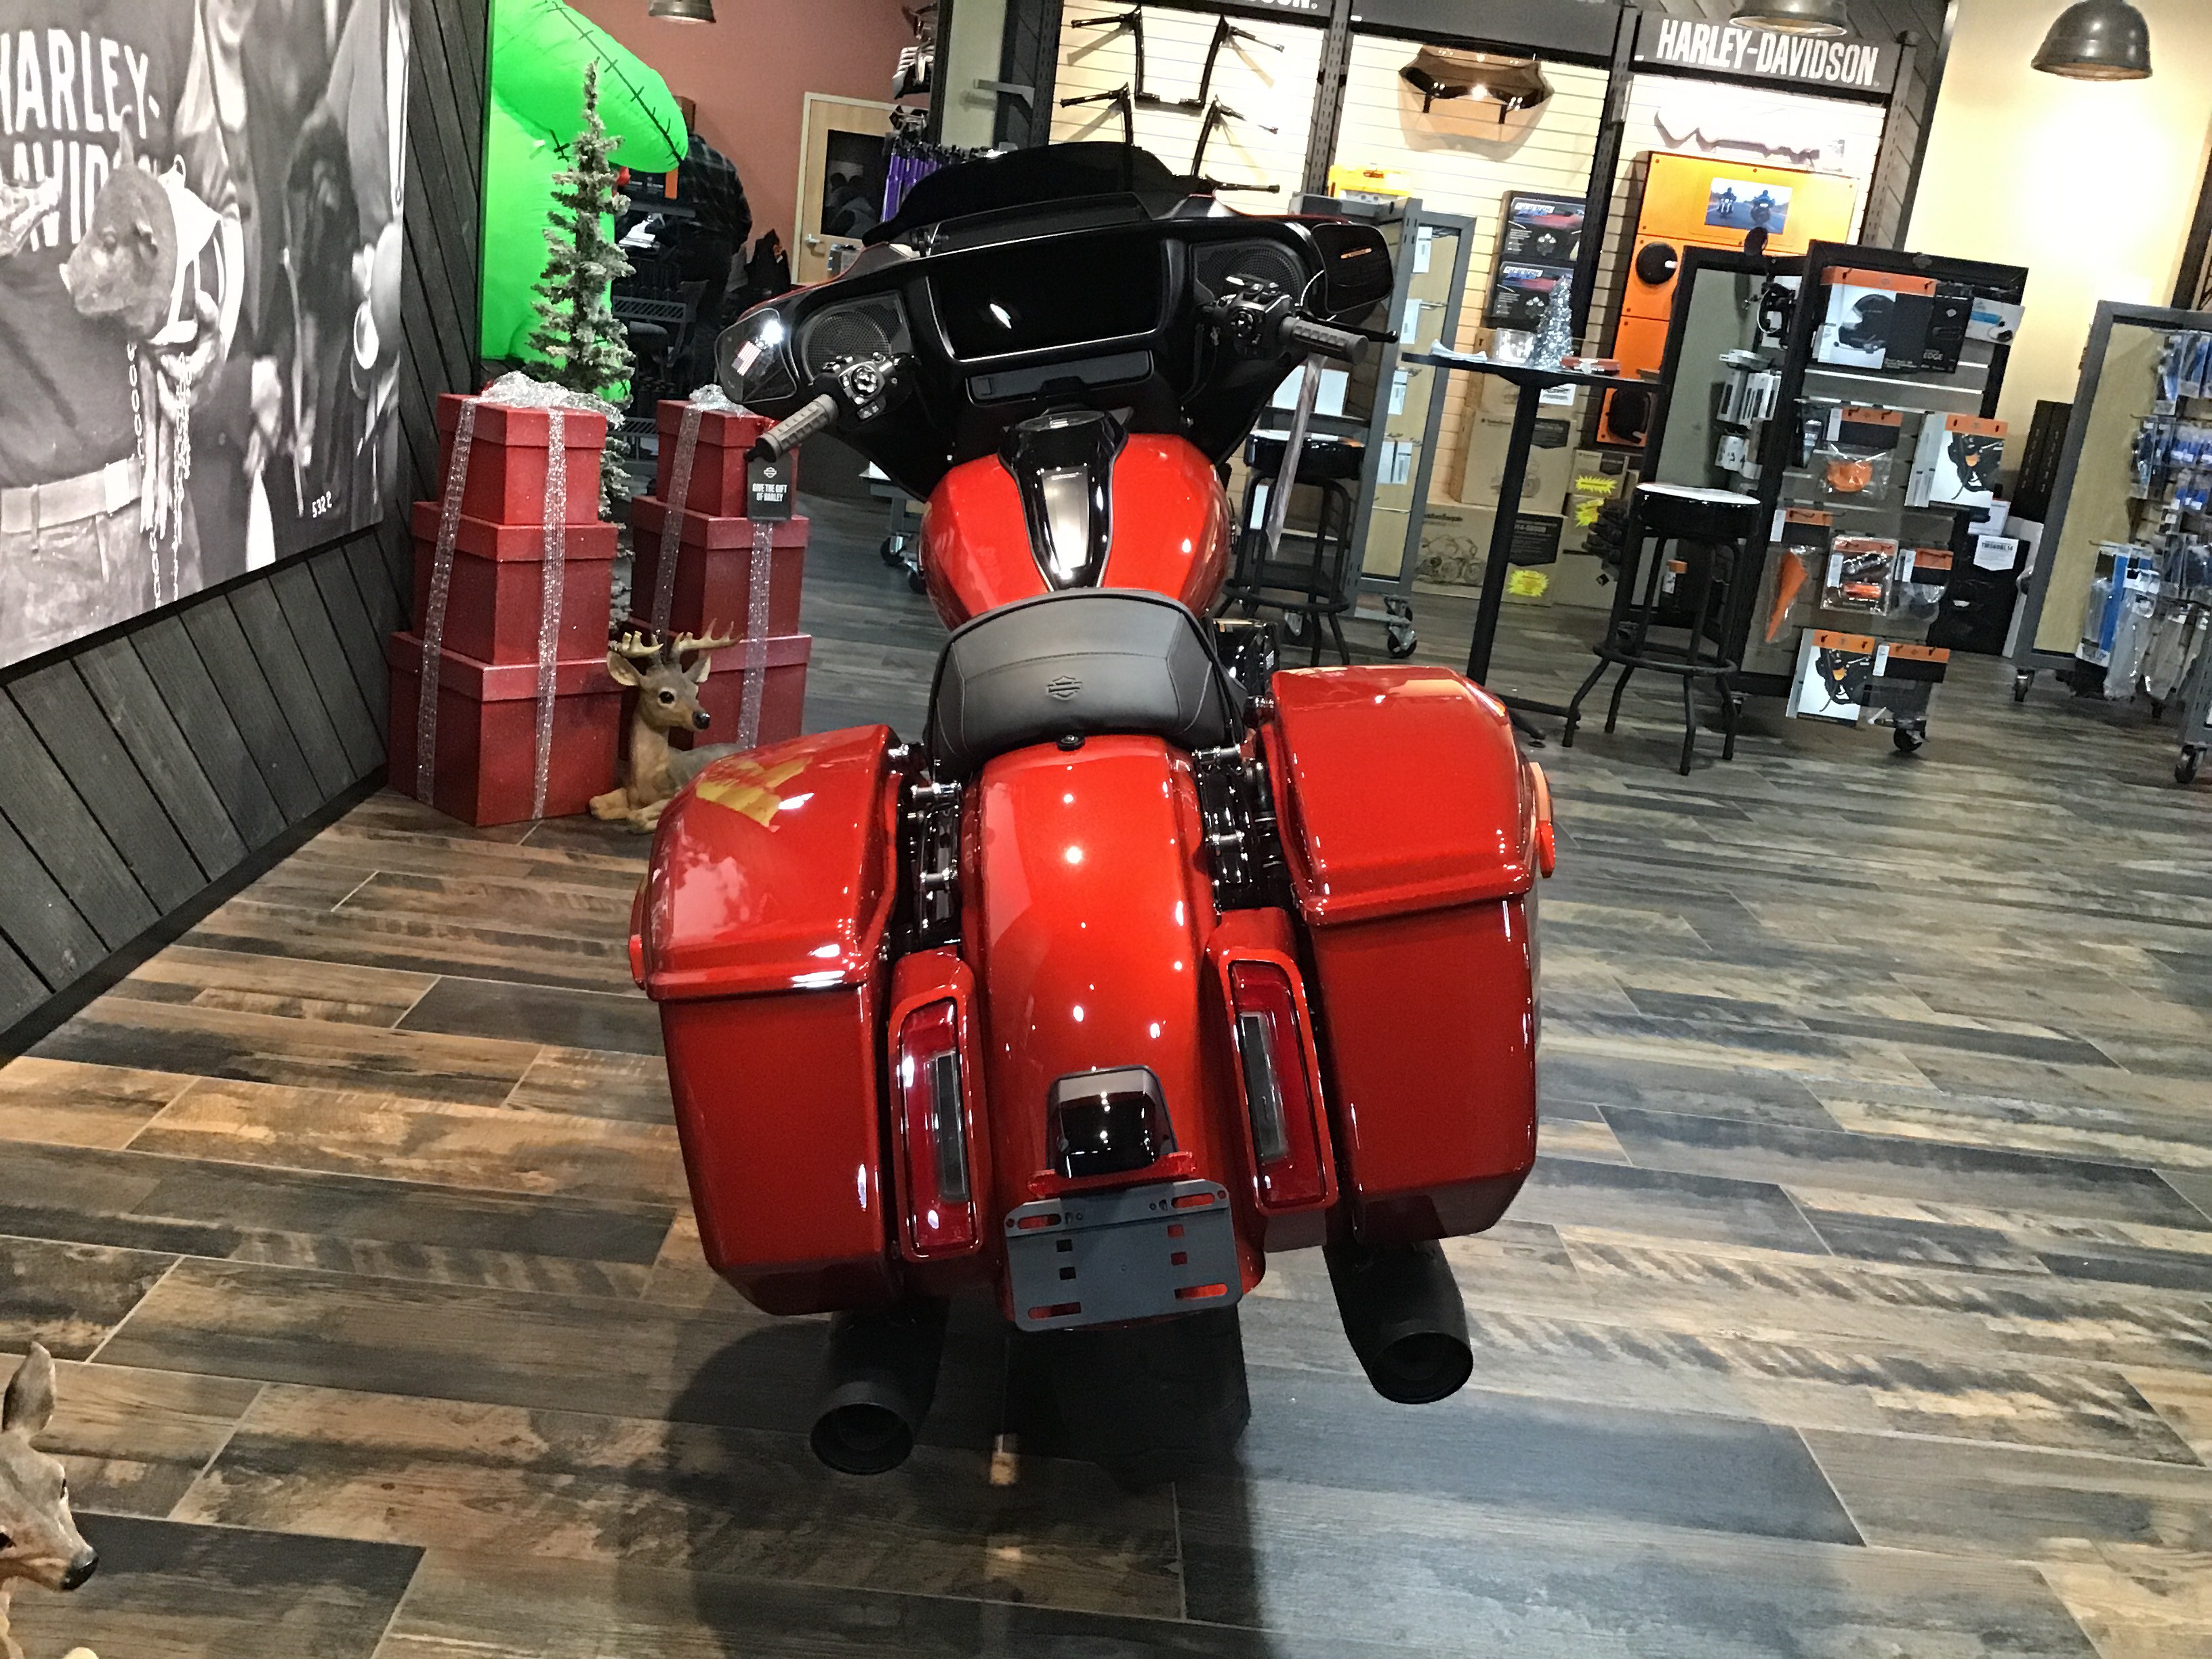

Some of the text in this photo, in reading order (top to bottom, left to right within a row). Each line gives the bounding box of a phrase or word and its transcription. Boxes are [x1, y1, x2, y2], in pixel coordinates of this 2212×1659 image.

[1656, 18, 1879, 86] HARLEY-DAVIDSON
[1923, 352, 1943, 361] EDGE
[765, 484, 775, 493] THE
[312, 491, 332, 518] 5322
